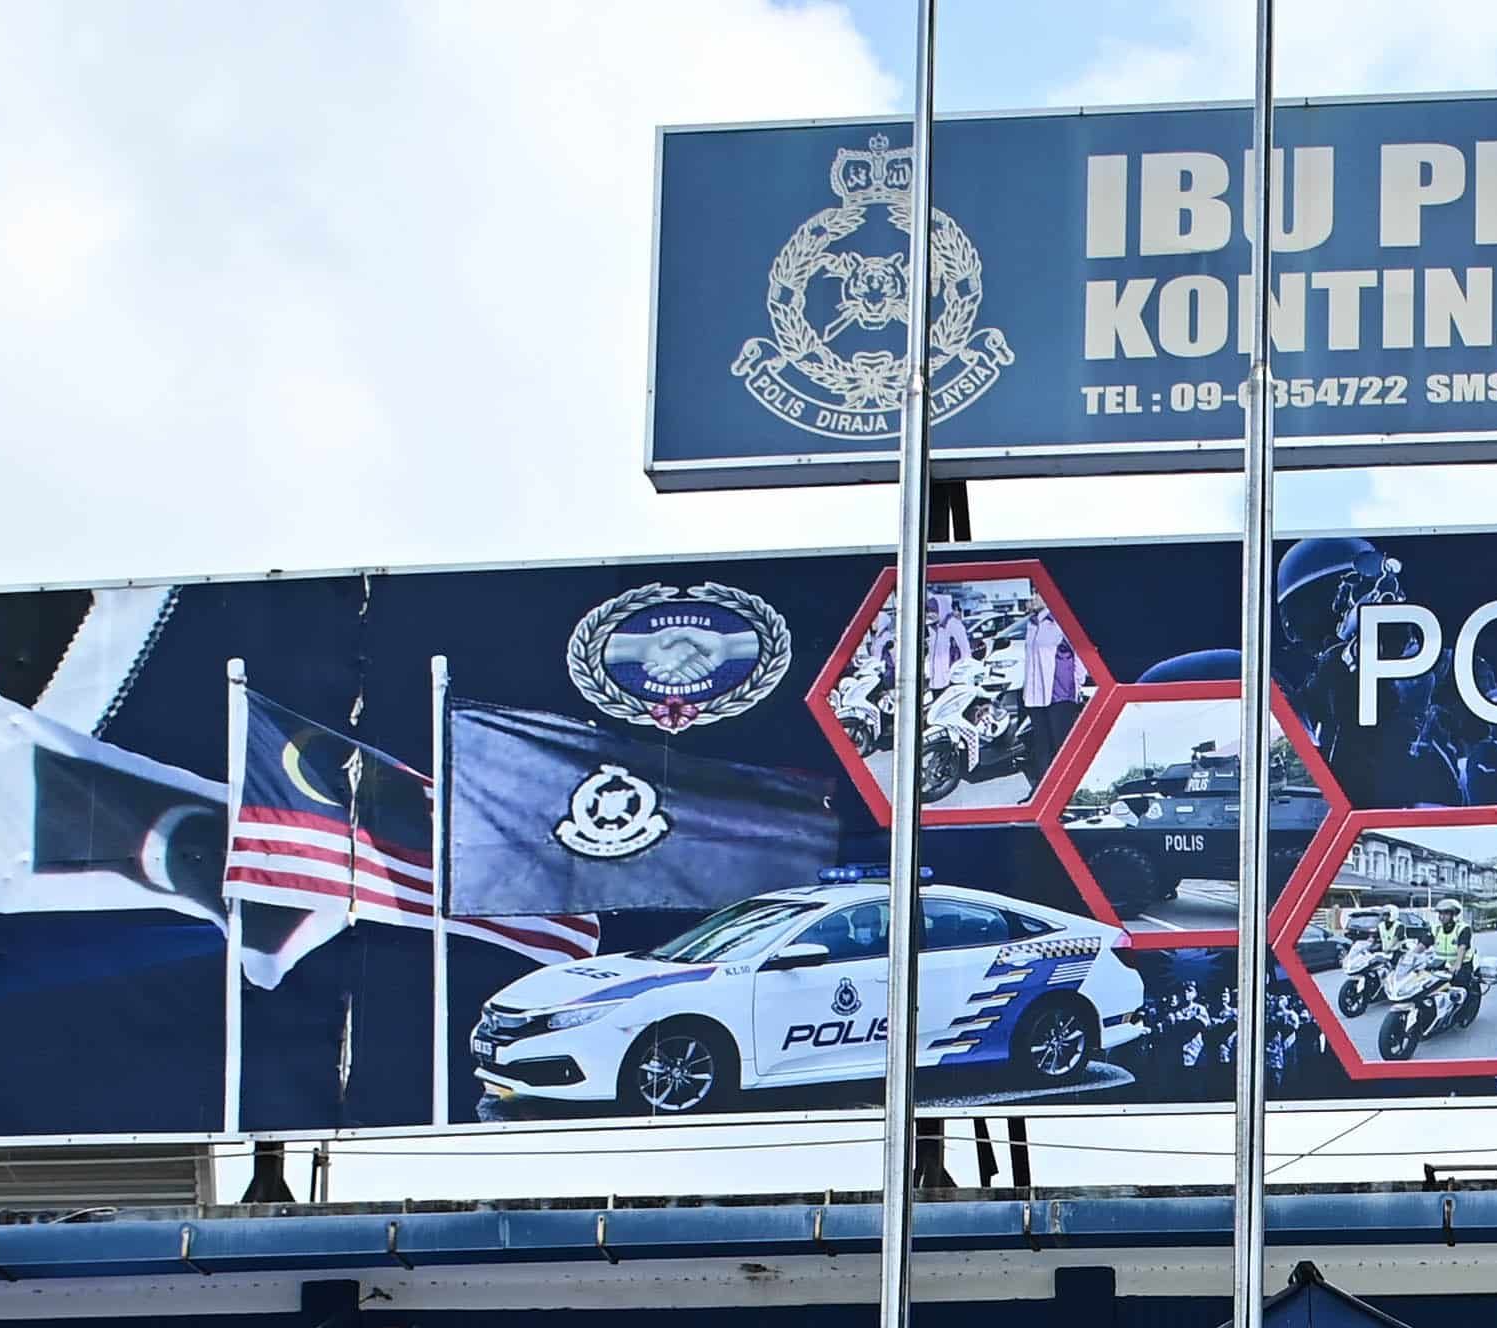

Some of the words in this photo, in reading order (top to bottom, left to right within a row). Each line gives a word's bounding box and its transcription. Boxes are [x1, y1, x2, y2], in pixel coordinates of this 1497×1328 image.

[1086, 146, 1335, 259] IBU
[752, 373, 806, 417] POLIS
[815, 409, 889, 433] DIRAJA
[1081, 385, 1143, 415] TEL
[1164, 834, 1205, 852] POLIS
